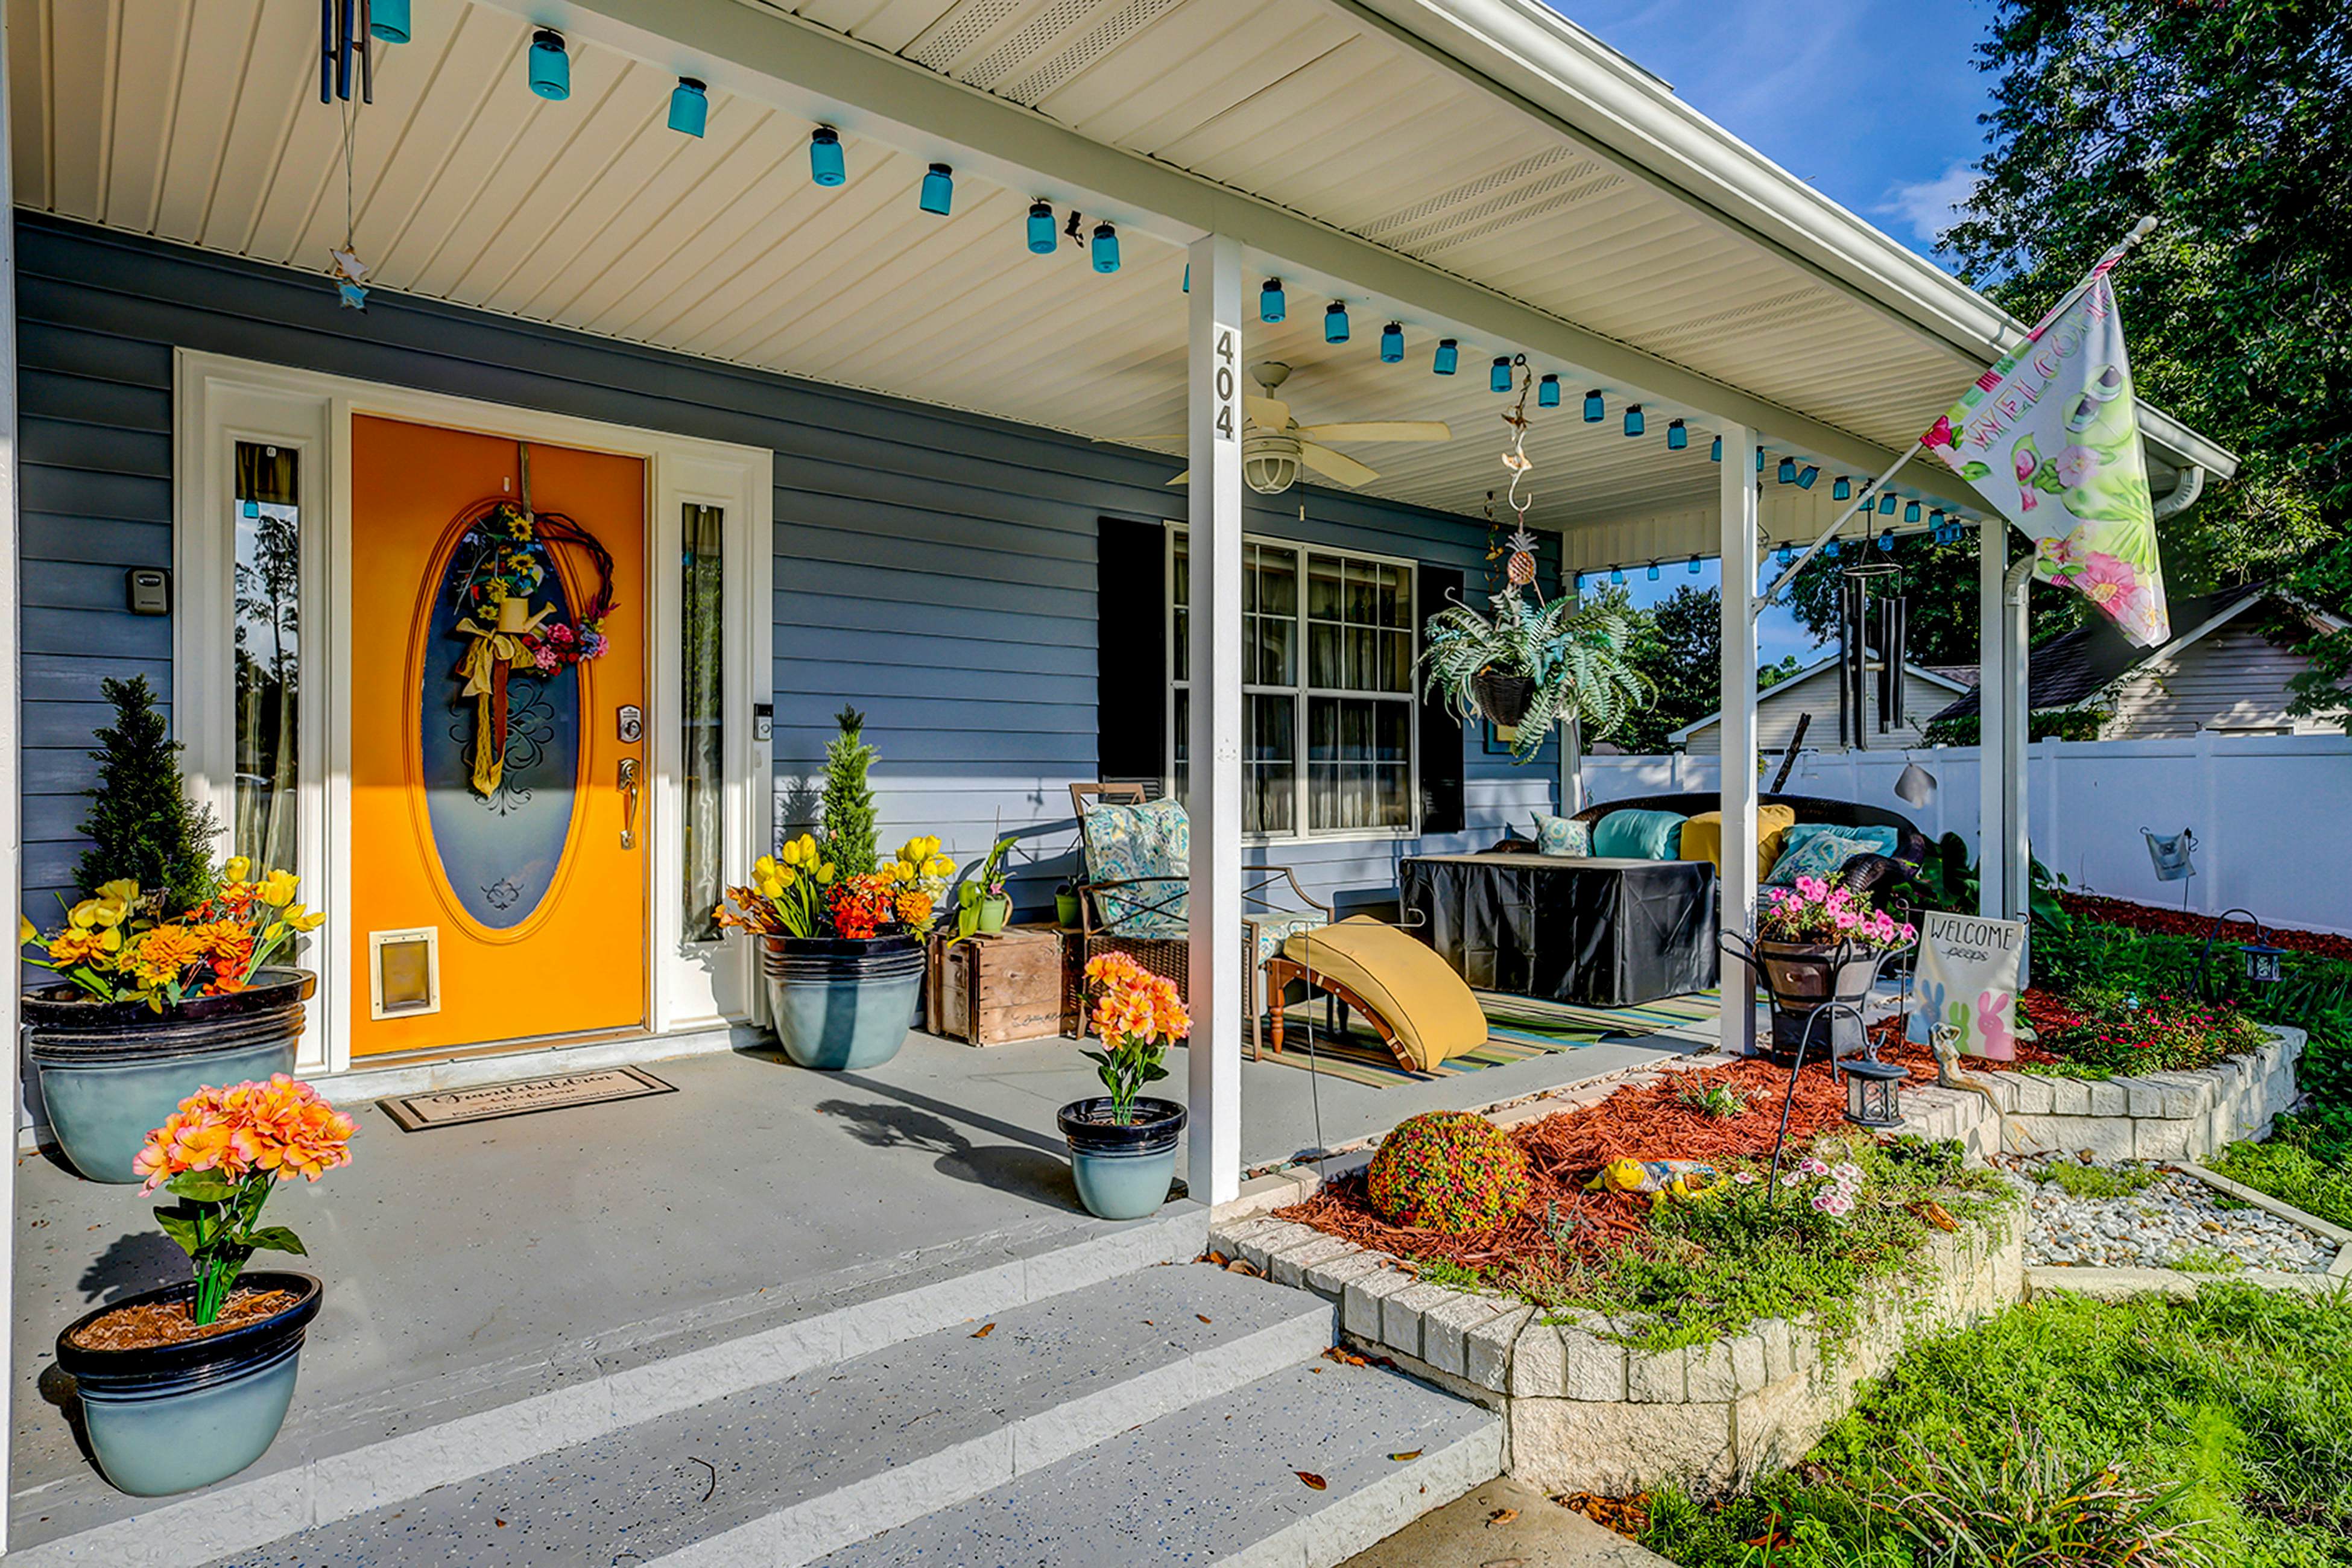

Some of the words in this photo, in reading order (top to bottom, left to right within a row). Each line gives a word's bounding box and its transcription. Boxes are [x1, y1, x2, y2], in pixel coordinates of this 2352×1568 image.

[1216, 330, 1234, 439] 404
[1930, 918, 2014, 950] WELCOME
[1941, 947, 1990, 964] peeps
